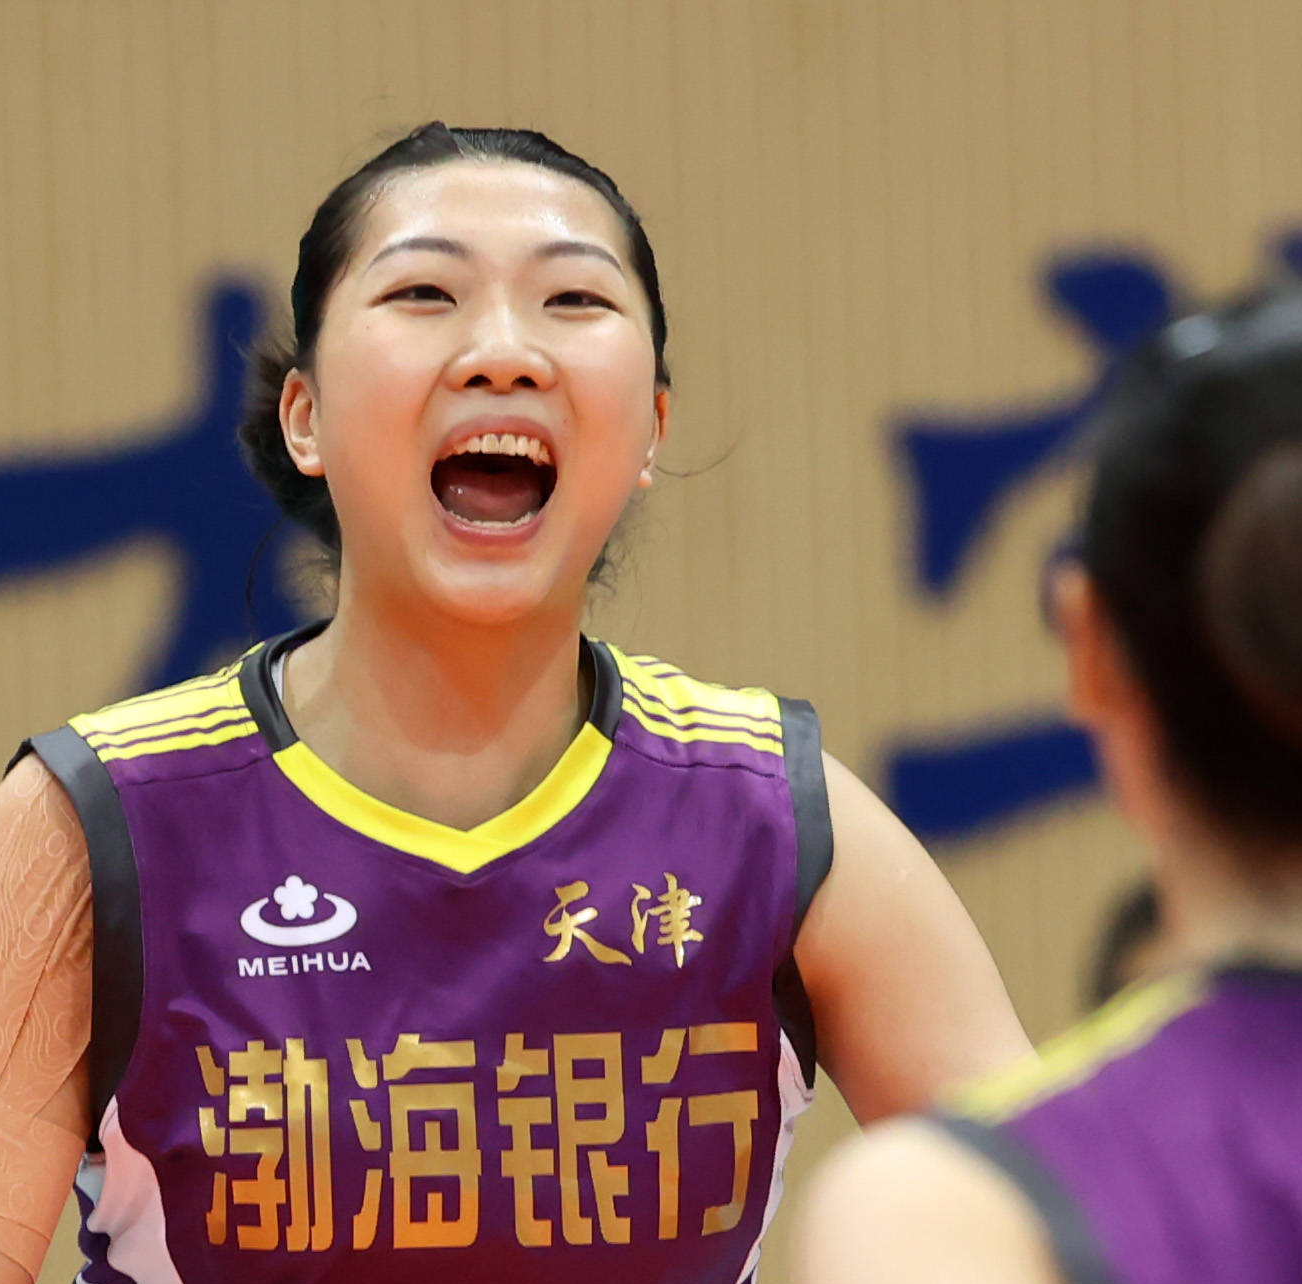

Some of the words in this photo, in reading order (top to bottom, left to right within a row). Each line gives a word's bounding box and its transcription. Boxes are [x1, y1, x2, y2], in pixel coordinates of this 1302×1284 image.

[237, 951, 372, 977] MEIHUA
[543, 873, 704, 968] 天津
[194, 1022, 760, 1252] 渤海银行
